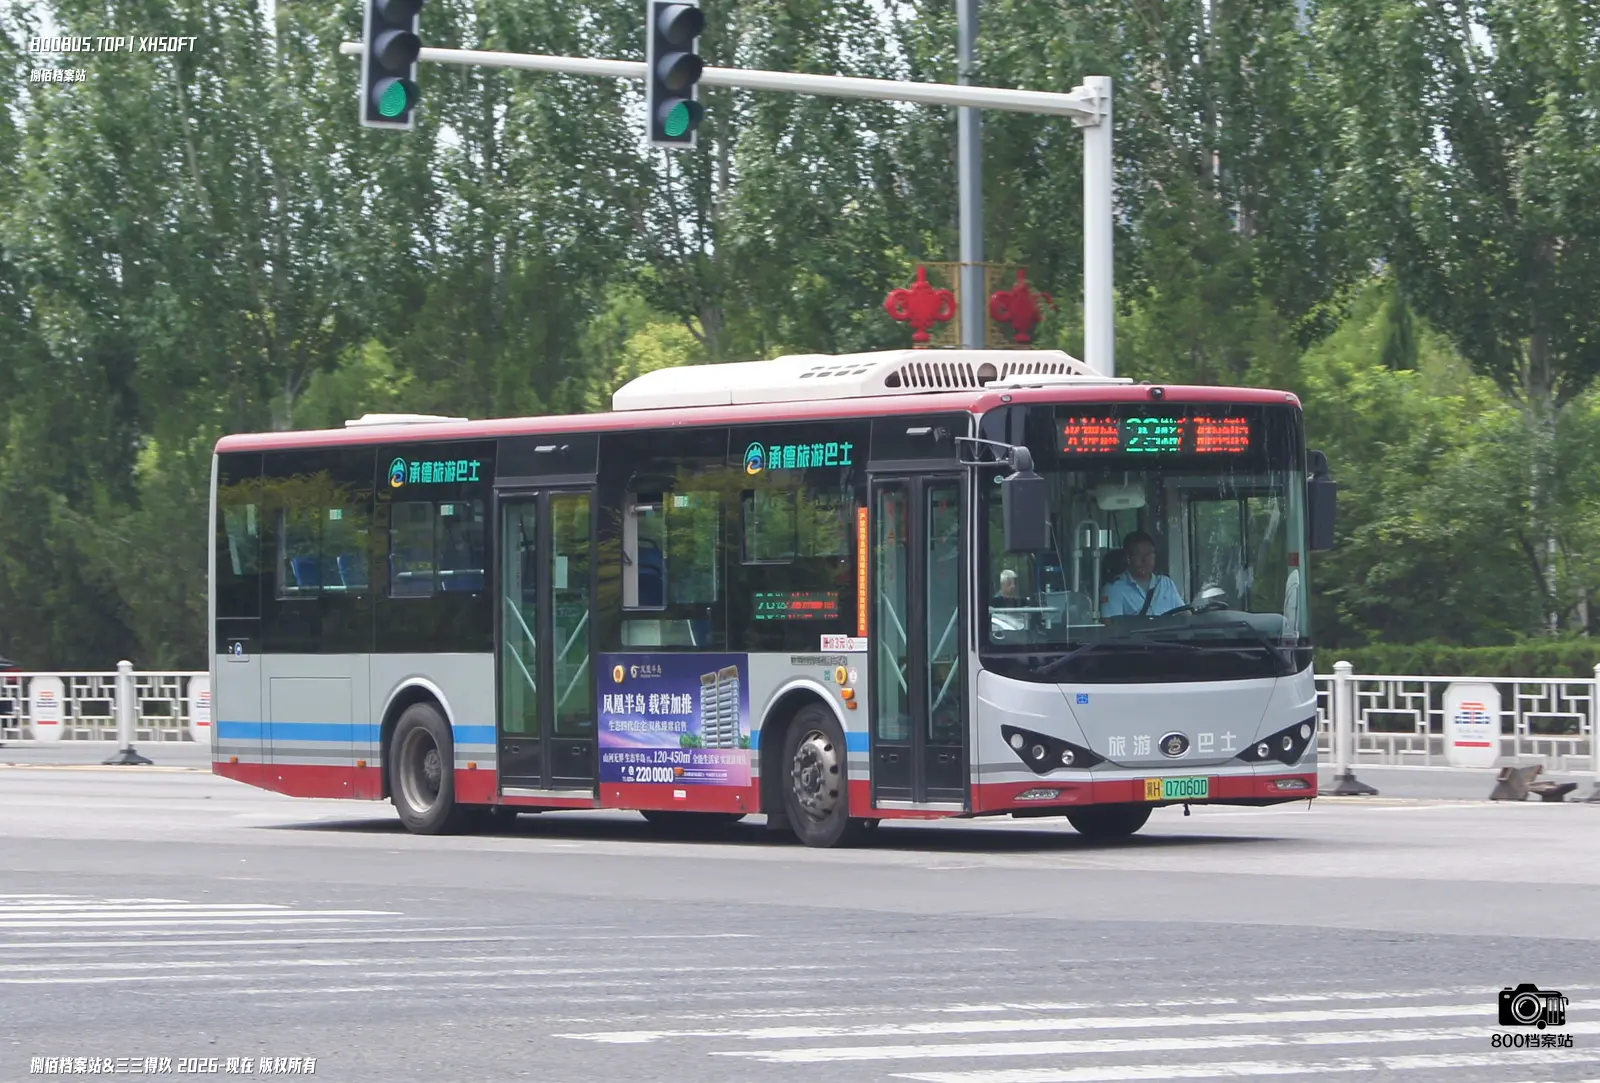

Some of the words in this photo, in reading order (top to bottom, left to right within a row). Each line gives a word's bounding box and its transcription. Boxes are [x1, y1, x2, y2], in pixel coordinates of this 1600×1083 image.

[768, 442, 853, 469] 承德旅游巴士
[409, 460, 480, 483] 承德旅游巴士
[603, 693, 646, 715] 凤凰半岛
[649, 693, 693, 715] 载誉加推
[1165, 779, 1208, 797] 07060D
